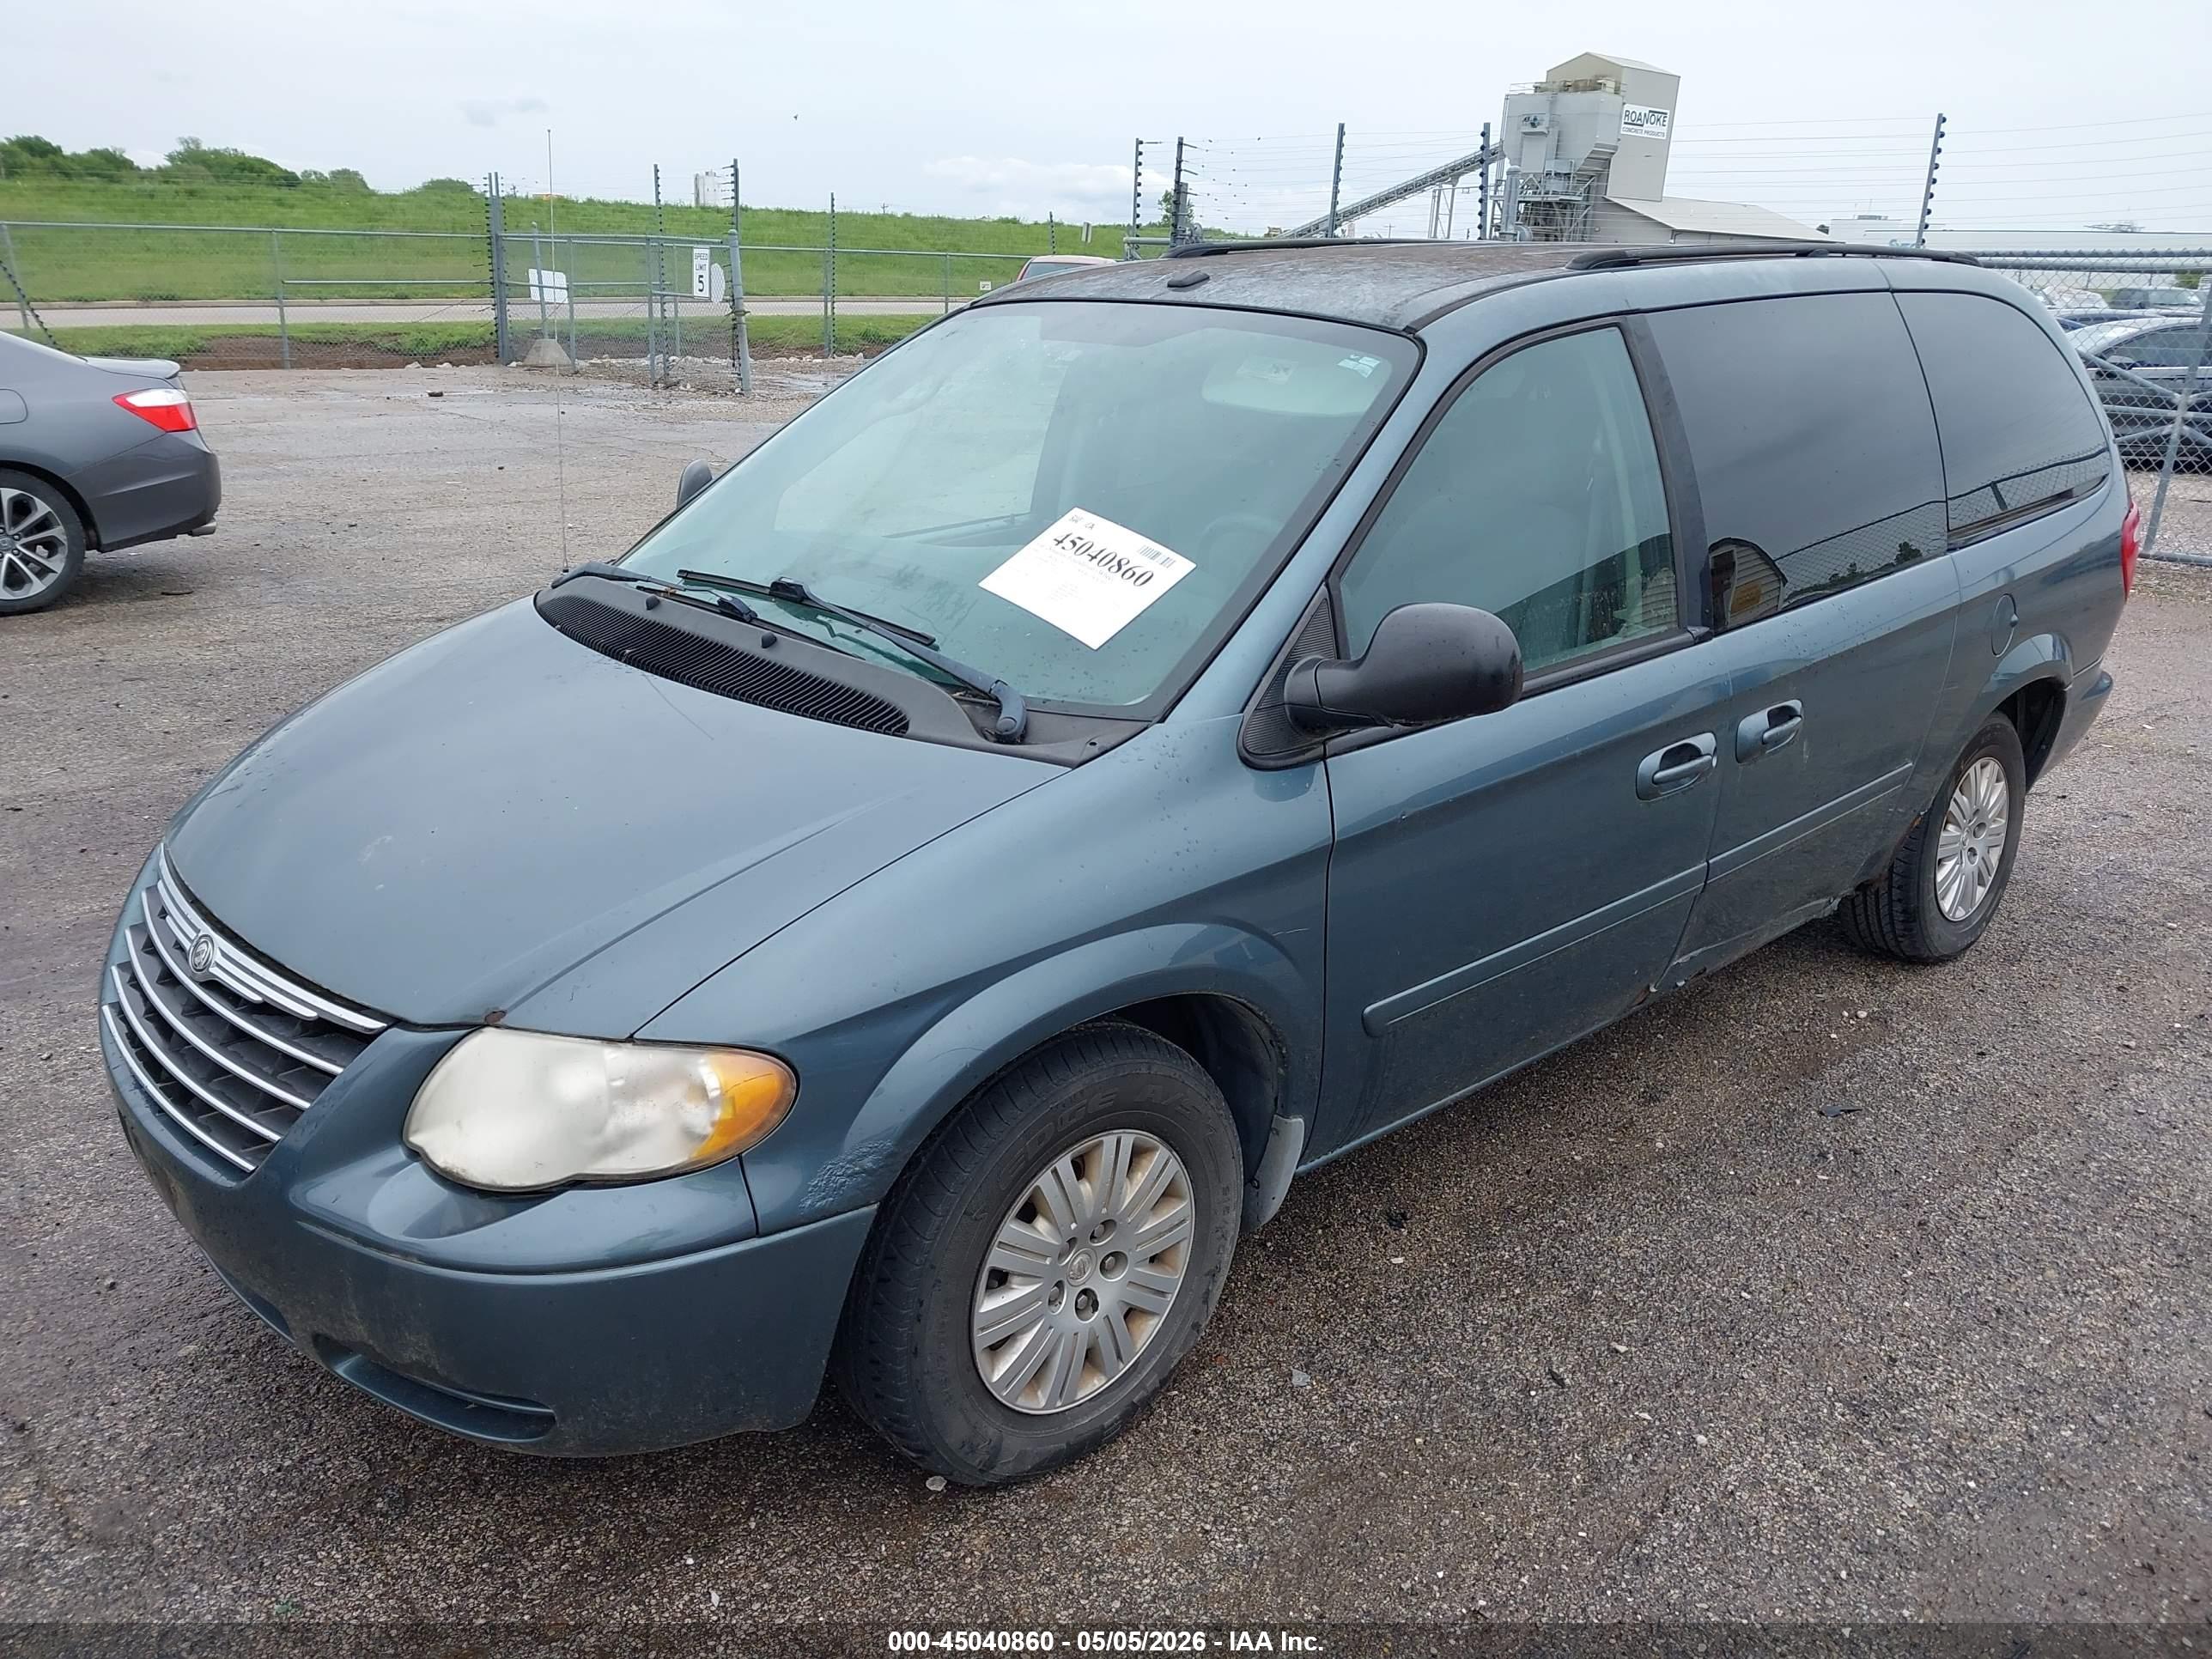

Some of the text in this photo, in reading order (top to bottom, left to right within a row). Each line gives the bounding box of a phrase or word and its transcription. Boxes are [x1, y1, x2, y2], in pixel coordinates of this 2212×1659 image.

[1624, 109, 1668, 127] ROANOKE
[698, 274, 704, 292] 5
[1053, 532, 1154, 586] 45040860
